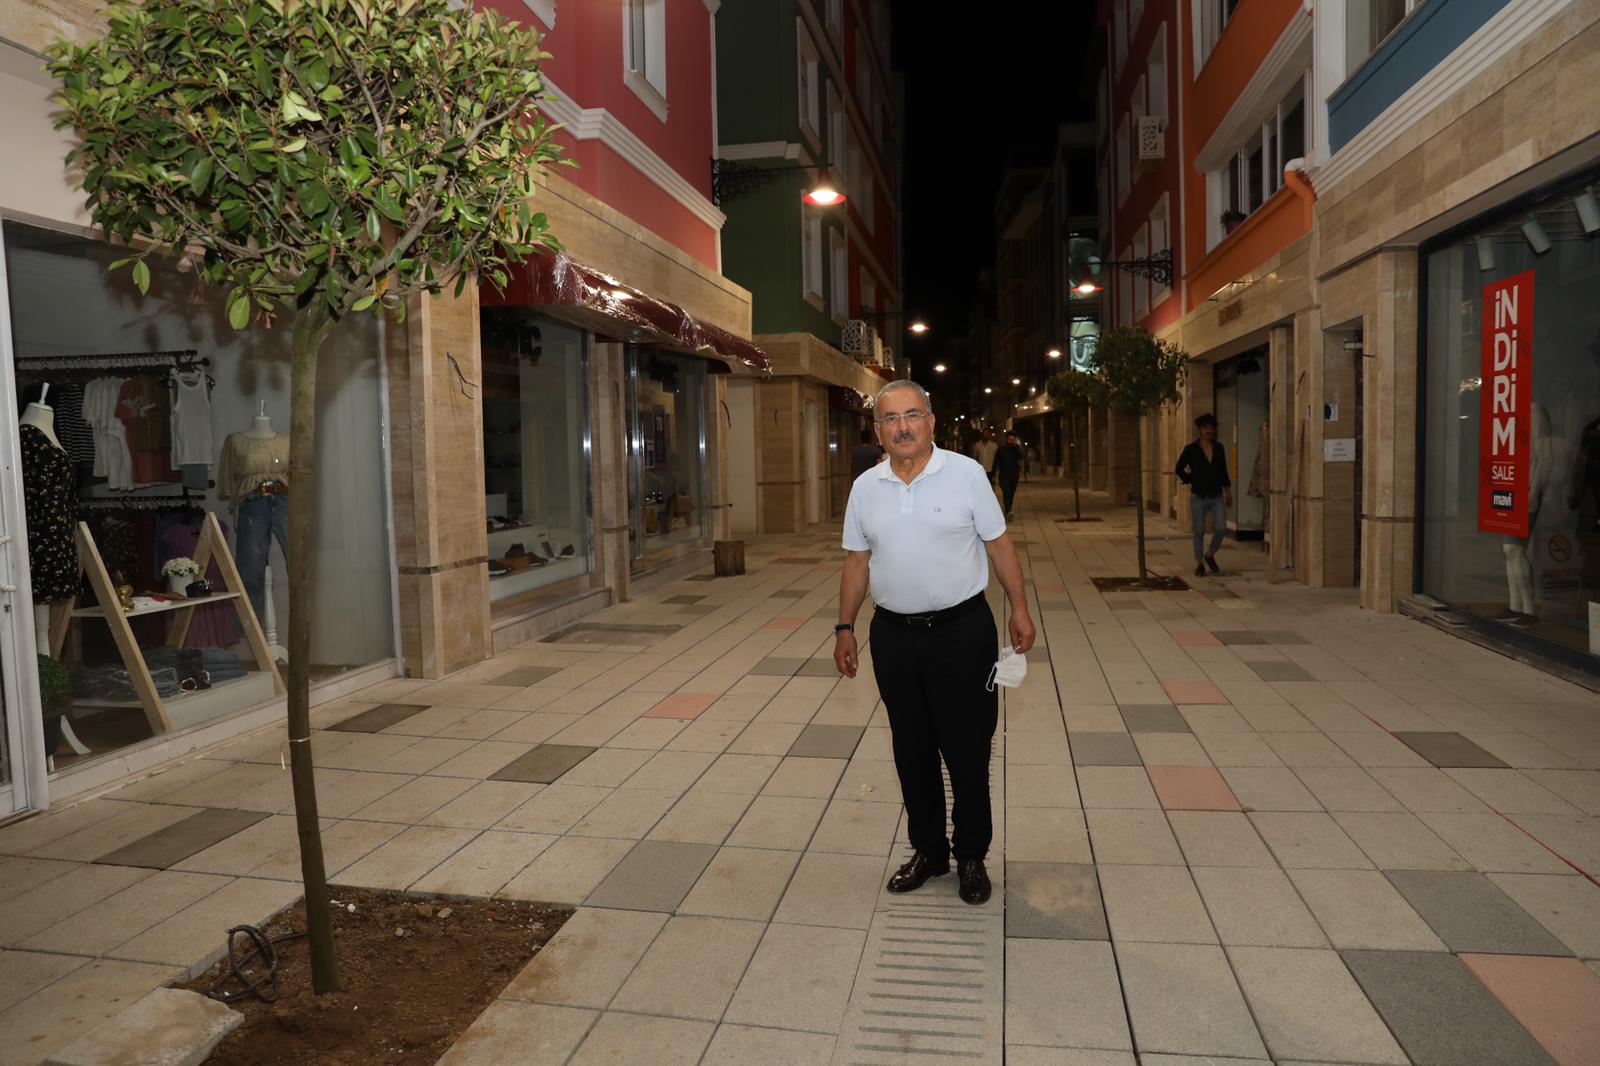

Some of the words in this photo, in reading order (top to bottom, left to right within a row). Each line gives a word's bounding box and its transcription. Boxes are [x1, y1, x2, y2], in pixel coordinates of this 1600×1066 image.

[1492, 416, 1516, 456] M
[1492, 465, 1515, 481] SALE
[1493, 492, 1512, 508] mavi
